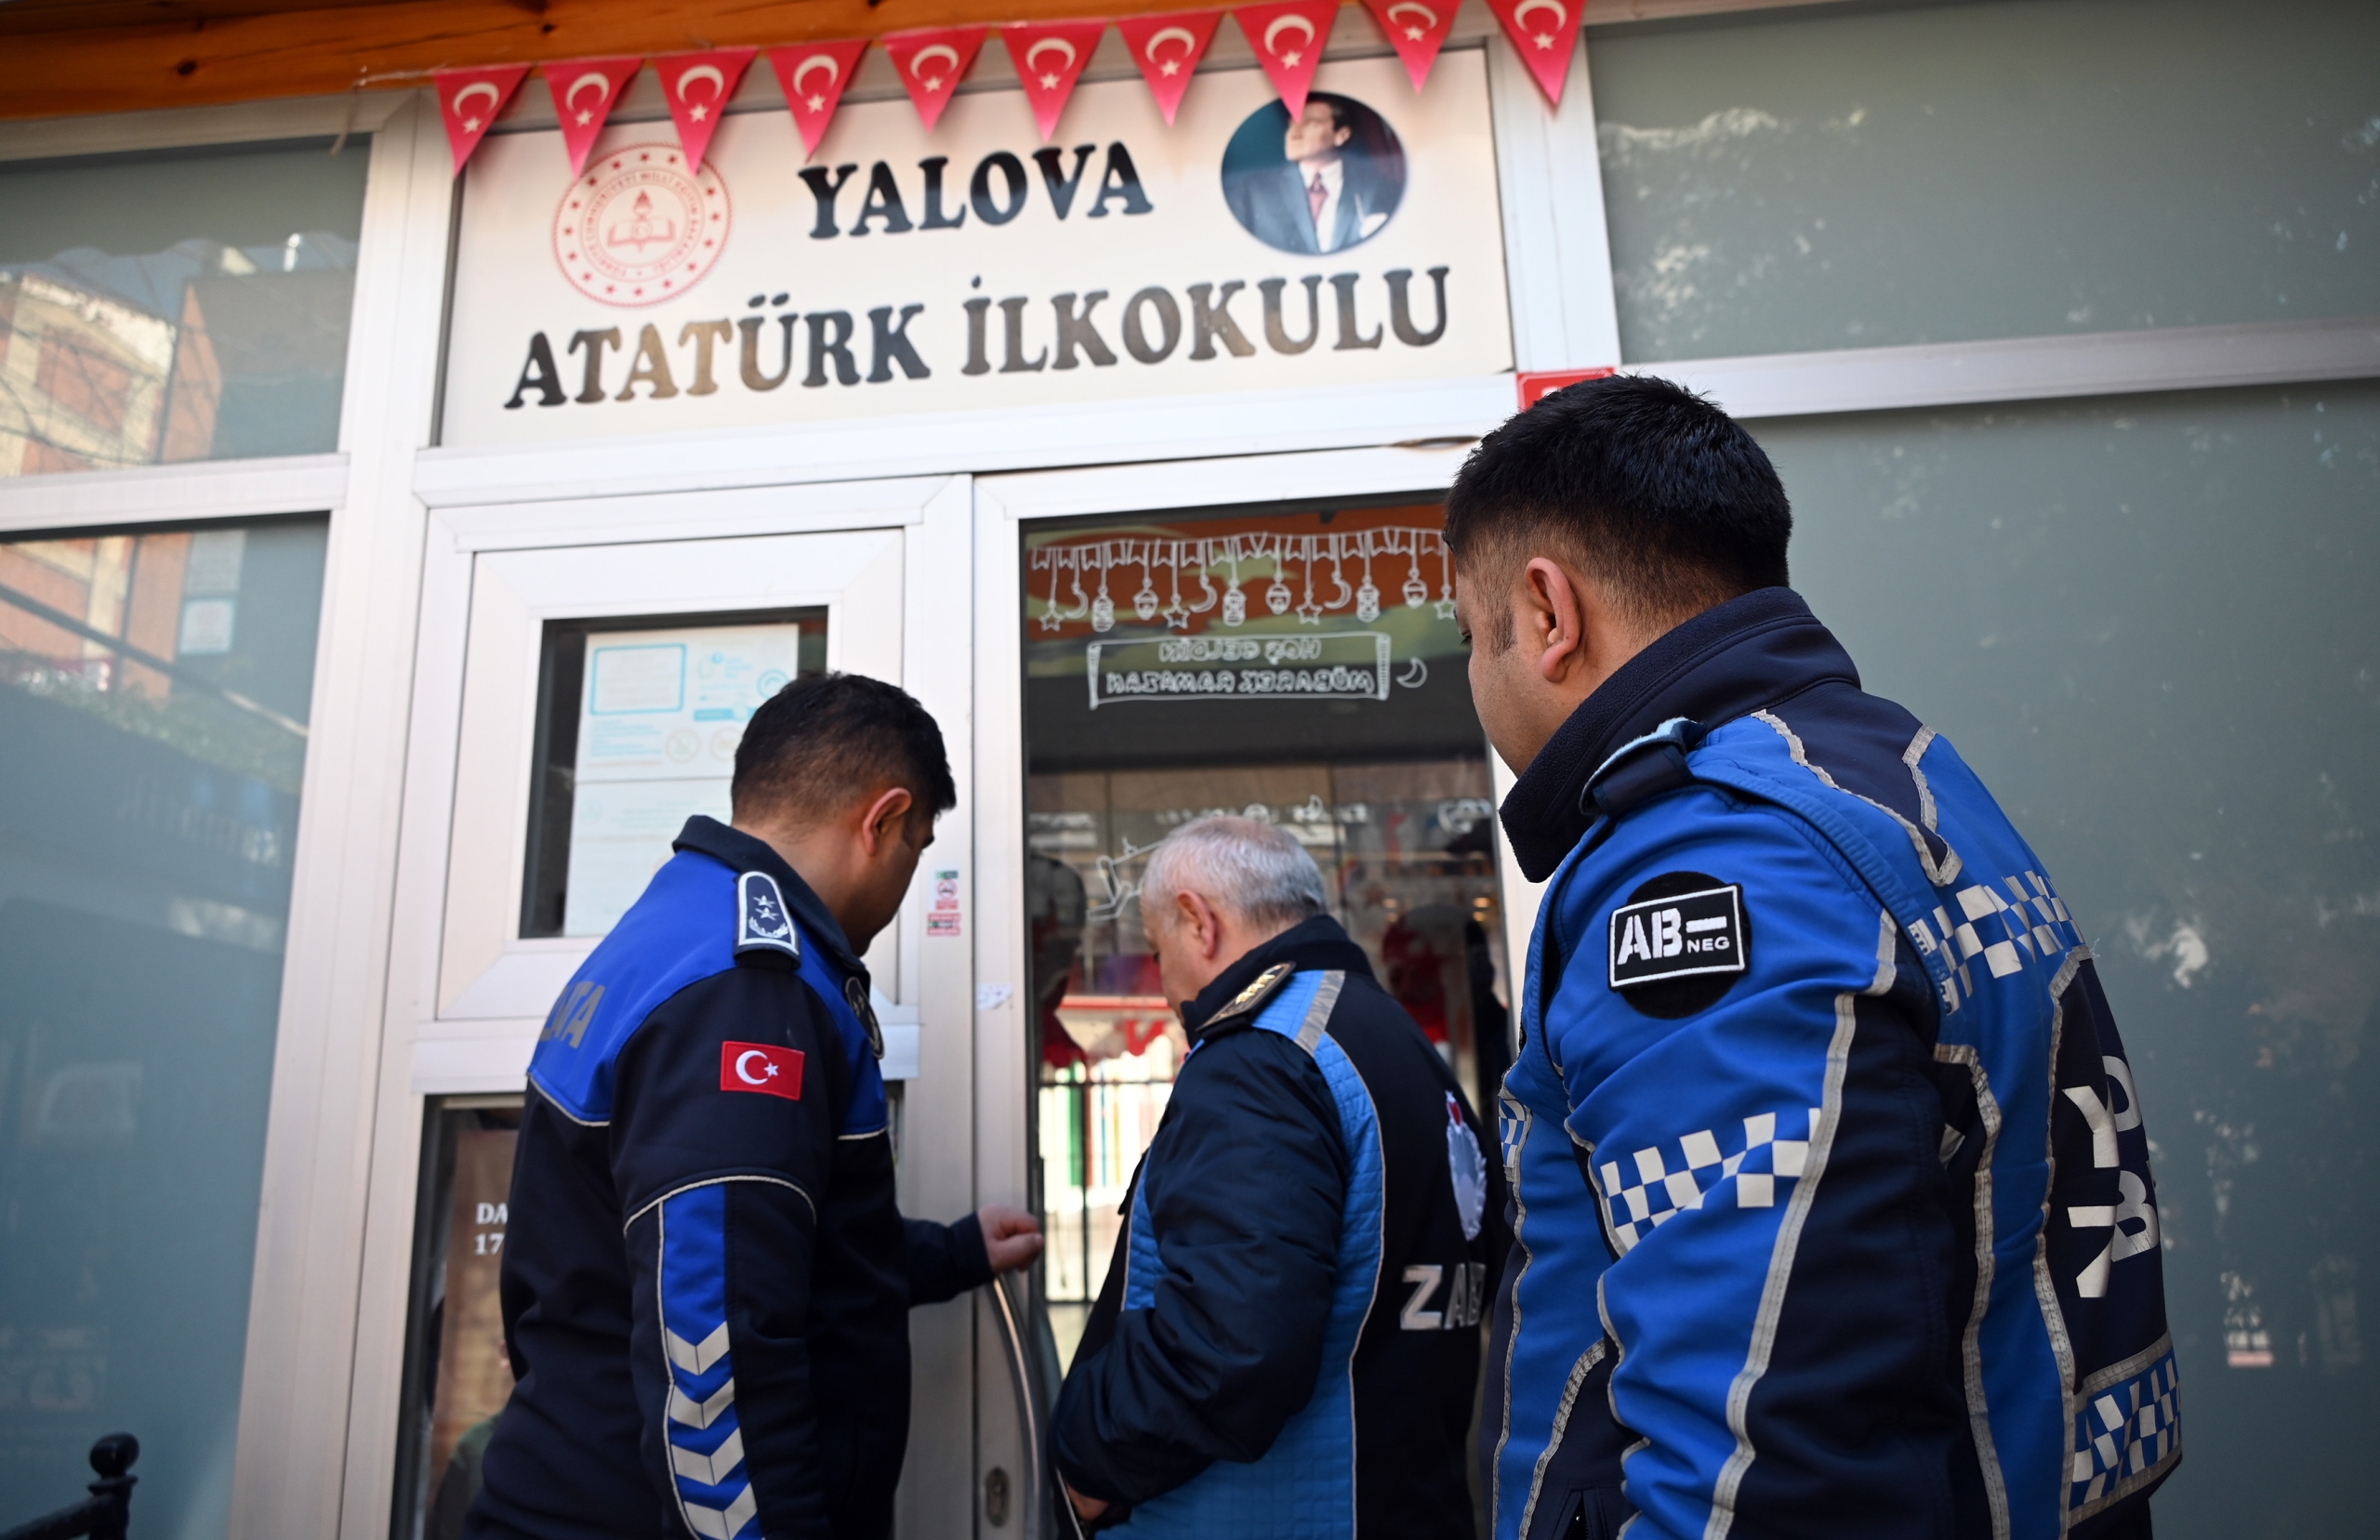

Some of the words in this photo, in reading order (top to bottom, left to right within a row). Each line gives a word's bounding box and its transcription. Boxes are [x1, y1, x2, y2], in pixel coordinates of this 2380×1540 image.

[797, 140, 1154, 241] YALOVA
[503, 293, 932, 411] ATATÜRK
[959, 266, 1450, 376] İLKOKULU
[1686, 936, 1730, 954] NEG
